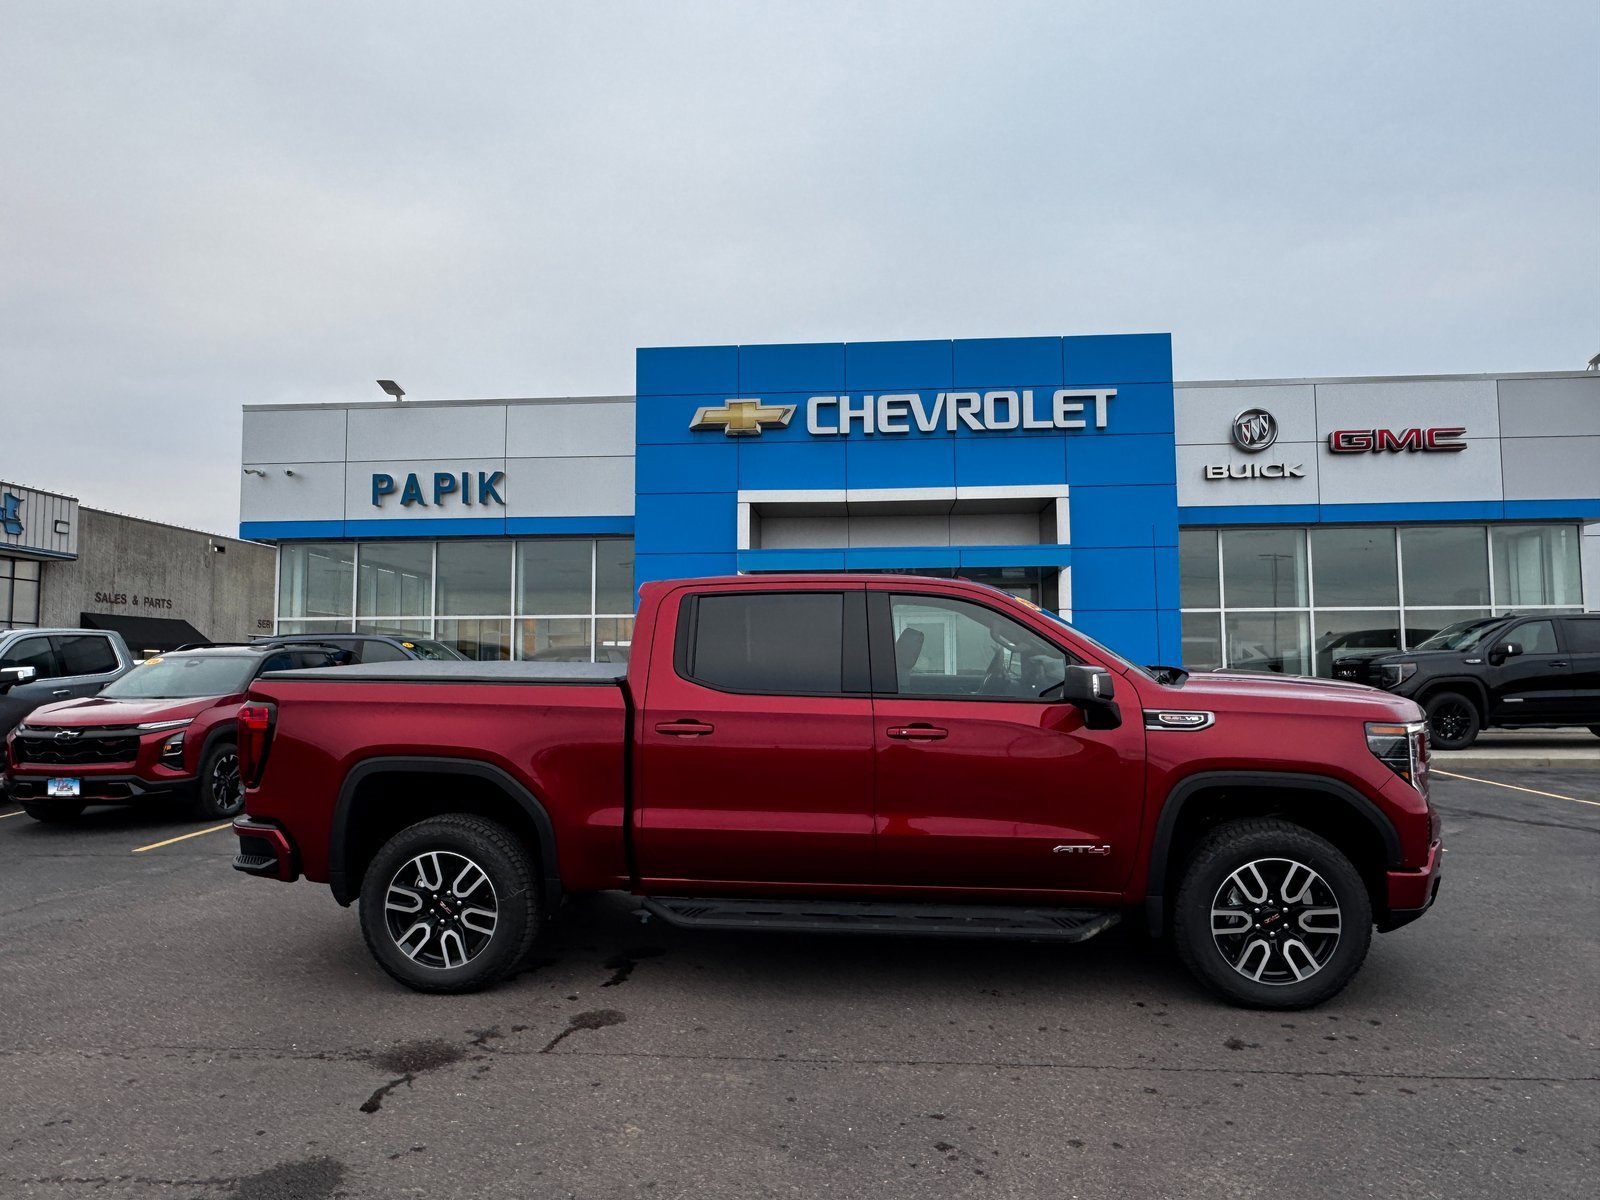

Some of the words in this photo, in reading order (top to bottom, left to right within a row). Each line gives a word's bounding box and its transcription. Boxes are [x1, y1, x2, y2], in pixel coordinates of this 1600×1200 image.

[806, 388, 1118, 434] CHEVROLET
[1329, 427, 1468, 453] GMC
[1205, 463, 1306, 480] BUICK
[372, 471, 506, 506] PAPIK
[95, 592, 127, 604] SALES
[132, 595, 138, 605] &
[143, 597, 172, 609] PARTS
[1053, 845, 1110, 856] AT4
